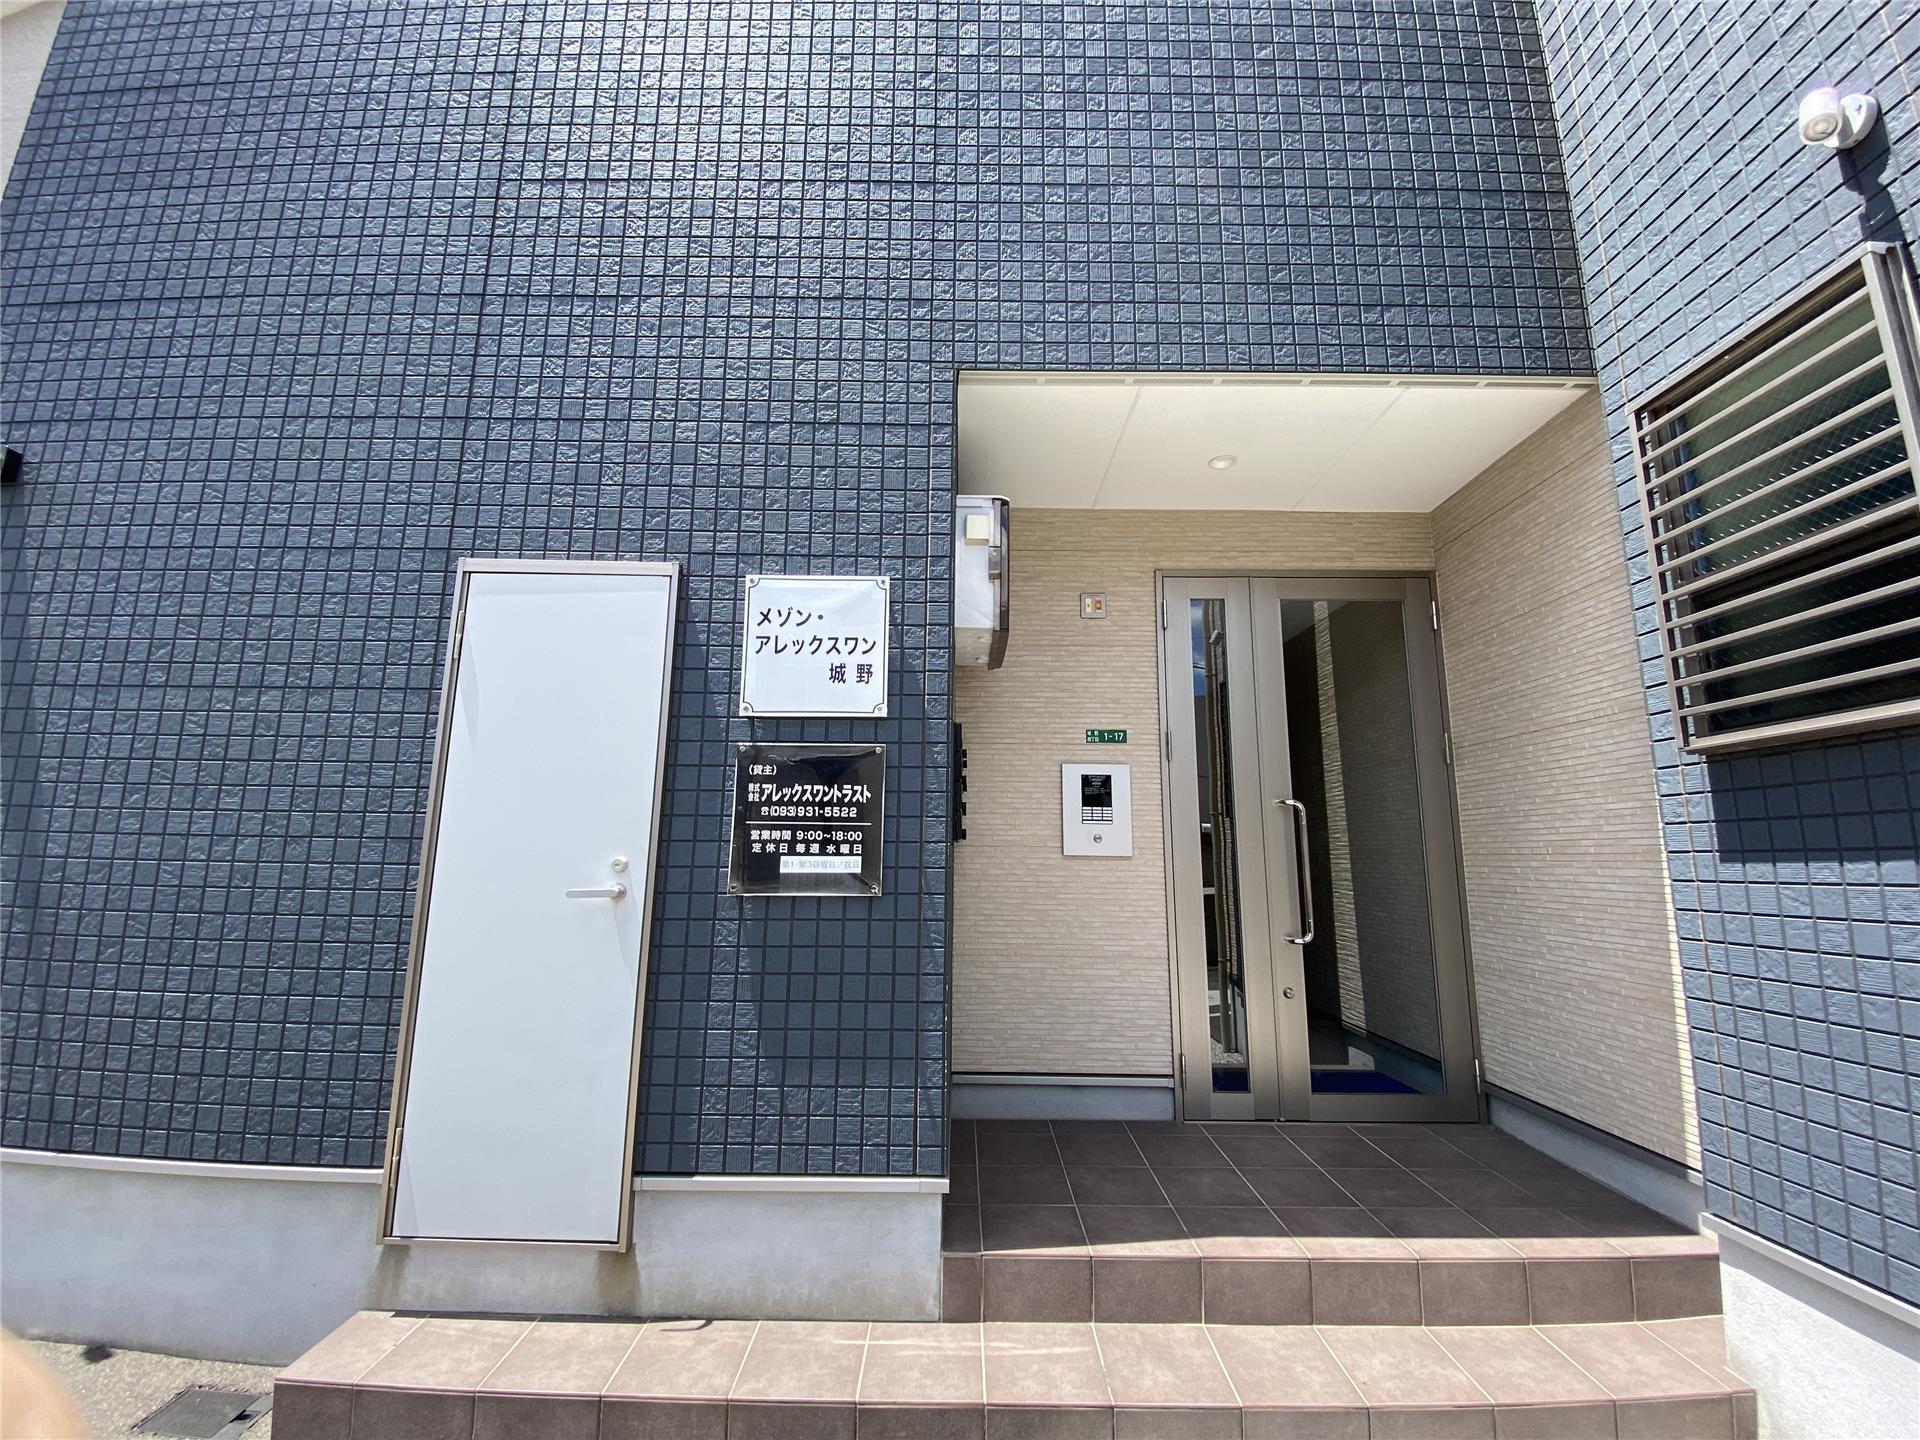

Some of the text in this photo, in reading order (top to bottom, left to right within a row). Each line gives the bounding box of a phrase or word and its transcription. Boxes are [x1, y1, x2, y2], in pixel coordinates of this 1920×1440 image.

[755, 634, 877, 656] アレックスワン
[1103, 732, 1124, 741] 1-17
[750, 829, 792, 841] 営業時間
